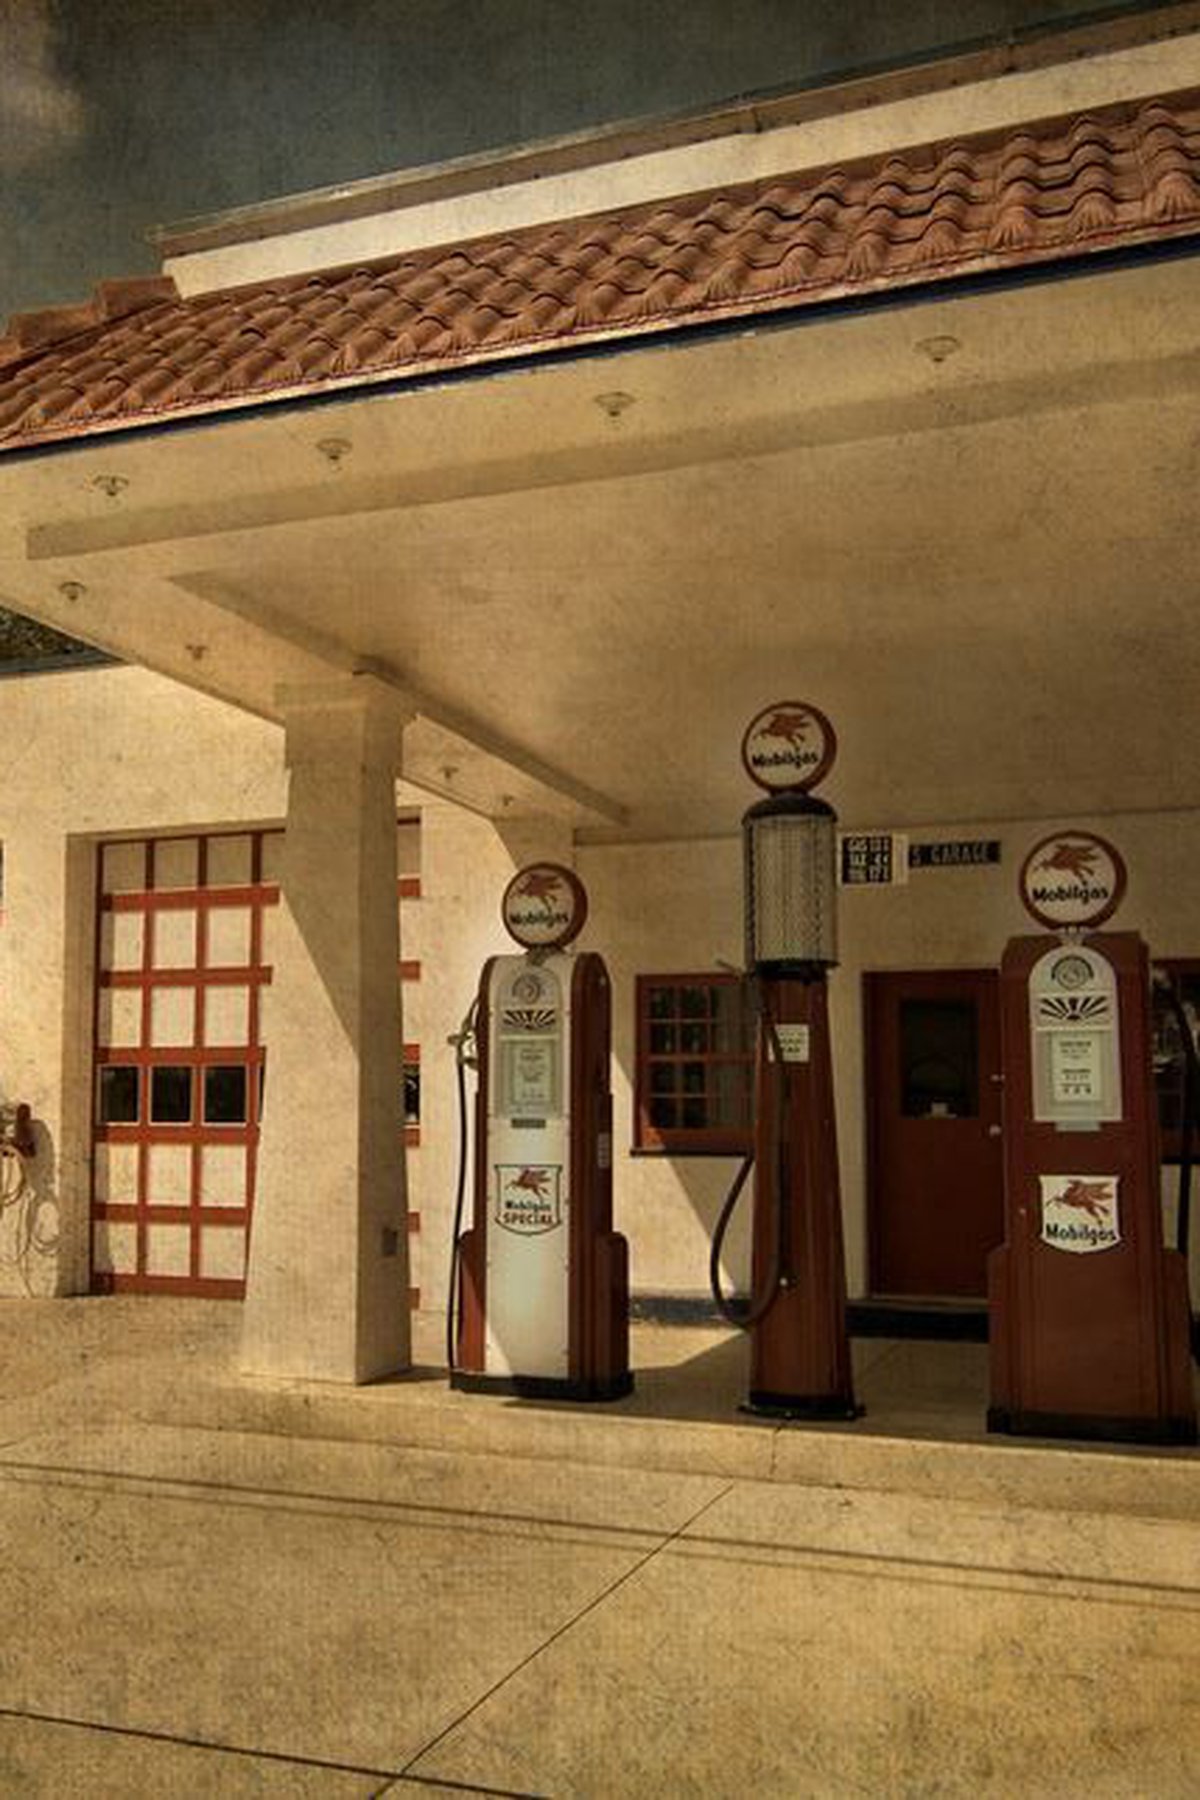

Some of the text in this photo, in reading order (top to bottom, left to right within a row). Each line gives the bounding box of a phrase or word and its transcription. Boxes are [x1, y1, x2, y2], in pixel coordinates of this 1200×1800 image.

[751, 752, 819, 769] Mobilgas
[931, 842, 988, 864] GARAGE
[1032, 884, 1109, 905] Mobilgas
[509, 911, 569, 929] Mobilgas
[503, 1212, 553, 1225] SPECIAL
[1045, 1223, 1117, 1246] Mobilgas
